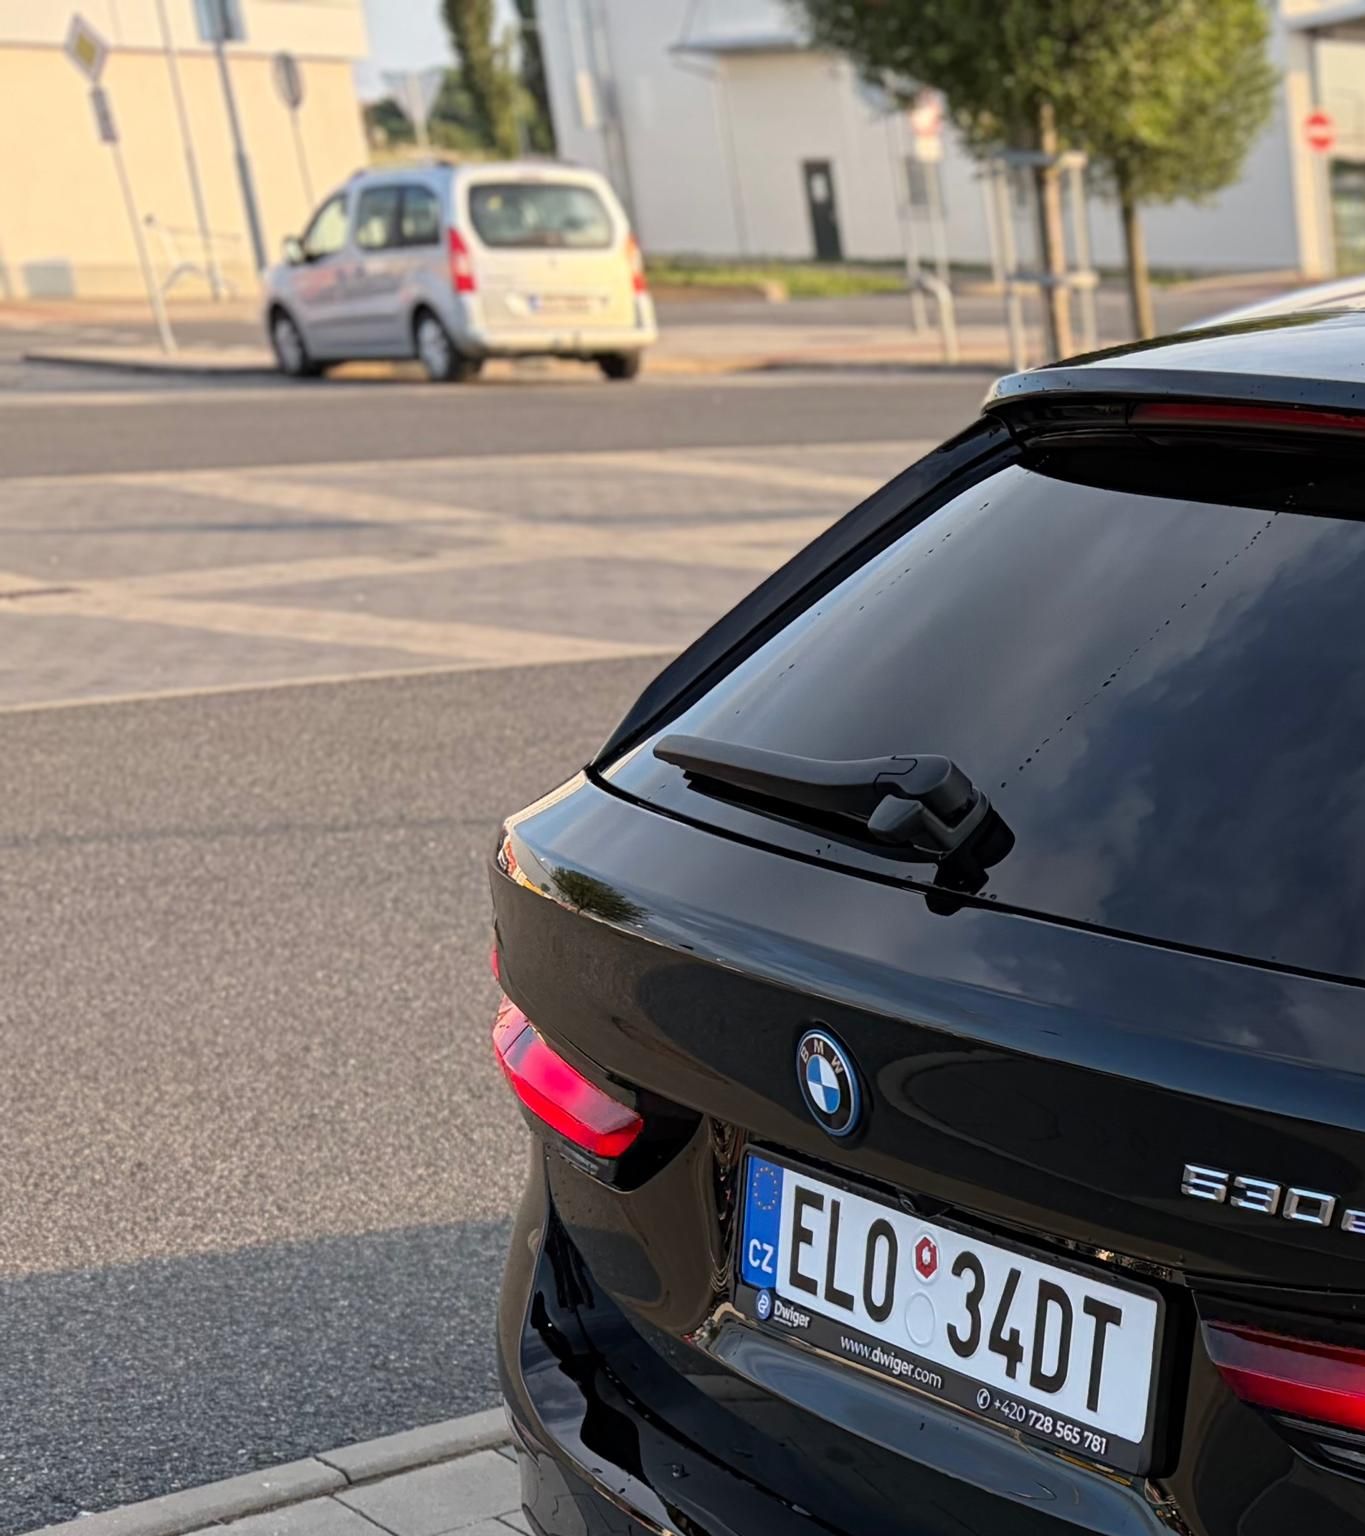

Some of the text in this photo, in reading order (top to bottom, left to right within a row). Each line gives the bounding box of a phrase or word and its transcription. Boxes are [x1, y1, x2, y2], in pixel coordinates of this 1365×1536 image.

[800, 1038, 844, 1075] BMW
[748, 1238, 774, 1275] CZ
[773, 1300, 811, 1329] Dwiger
[946, 1250, 1123, 1414] 34DT
[840, 1335, 943, 1389] www.dwiger.com
[993, 1399, 1107, 1455] +420 728 565 781
